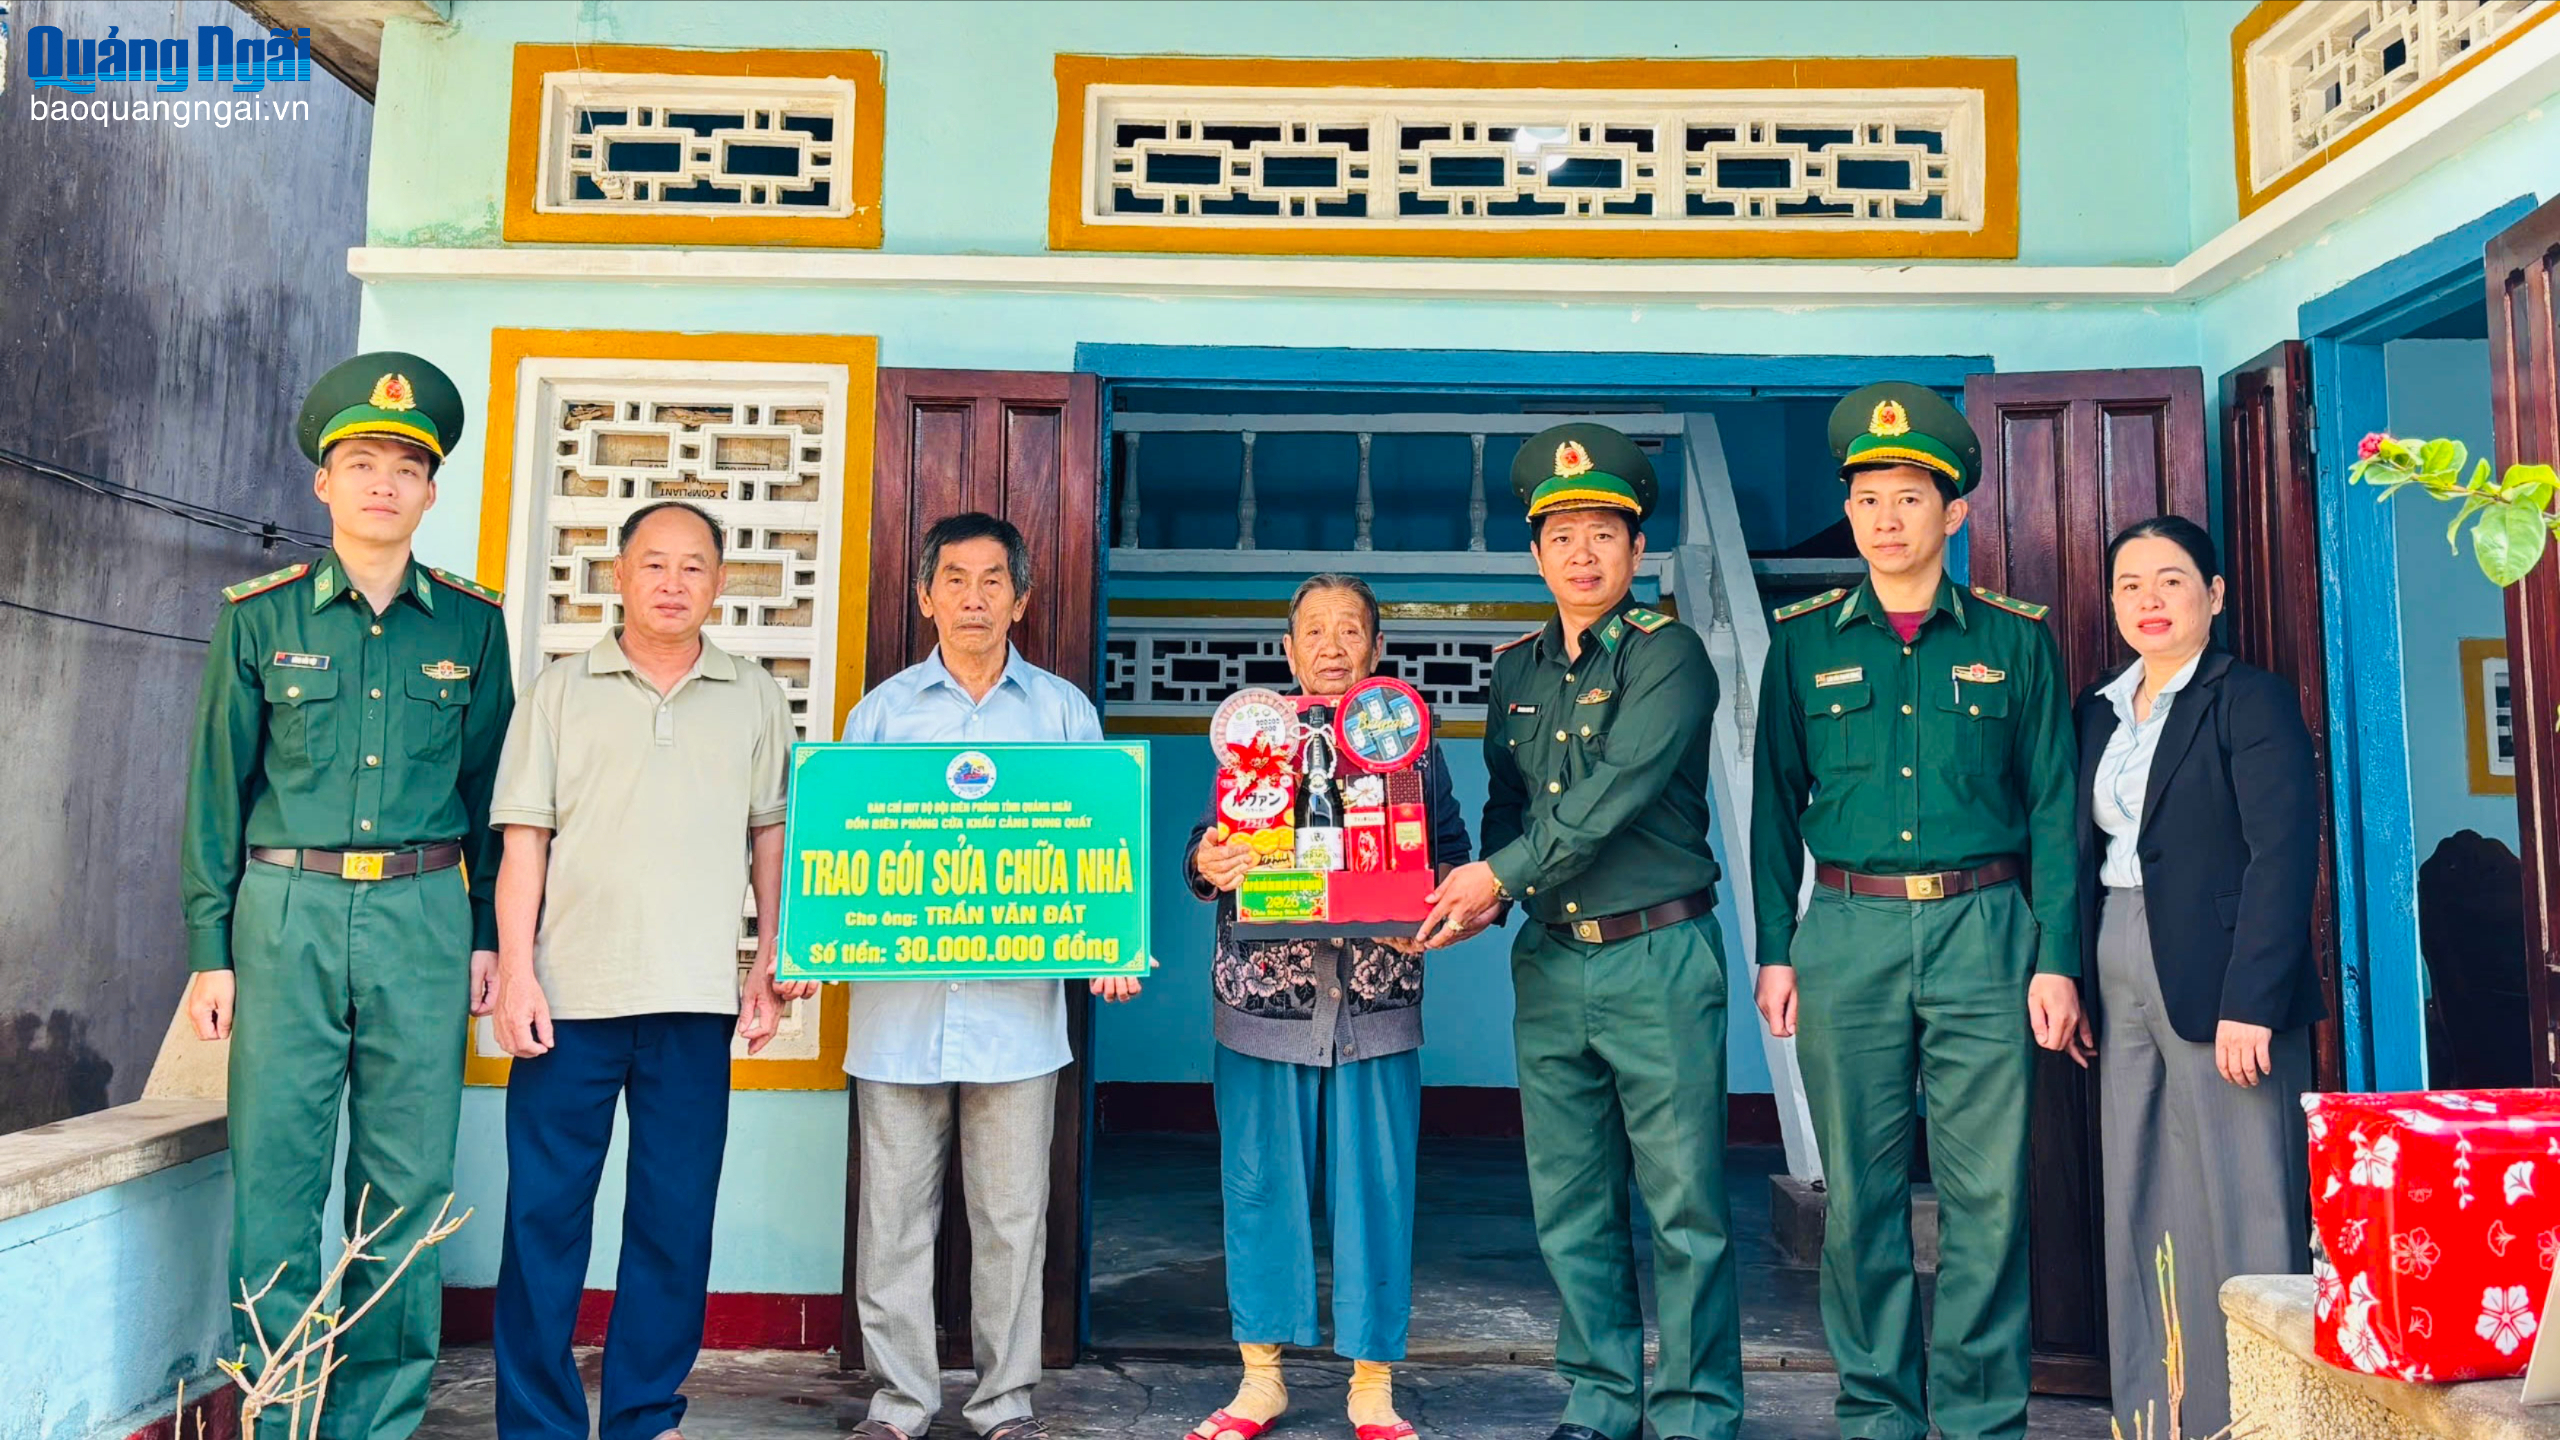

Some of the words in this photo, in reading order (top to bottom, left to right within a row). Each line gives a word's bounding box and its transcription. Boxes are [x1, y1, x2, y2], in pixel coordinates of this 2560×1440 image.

[659, 487, 716, 498] COMPLIANT
[800, 849, 870, 896] TRAO
[877, 839, 925, 896] GÓI
[931, 833, 988, 896] SỬA
[995, 839, 1069, 895] CHỮA
[1076, 837, 1134, 894] NHÀ
[845, 911, 878, 926] Cho
[881, 911, 918, 927] ông:
[991, 901, 1037, 925] VĂN
[1265, 894, 1300, 909] 2026
[809, 939, 839, 964] Số
[841, 939, 888, 963] tiền:
[895, 934, 1045, 964] 30.000.000
[1053, 929, 1120, 964] đồng
